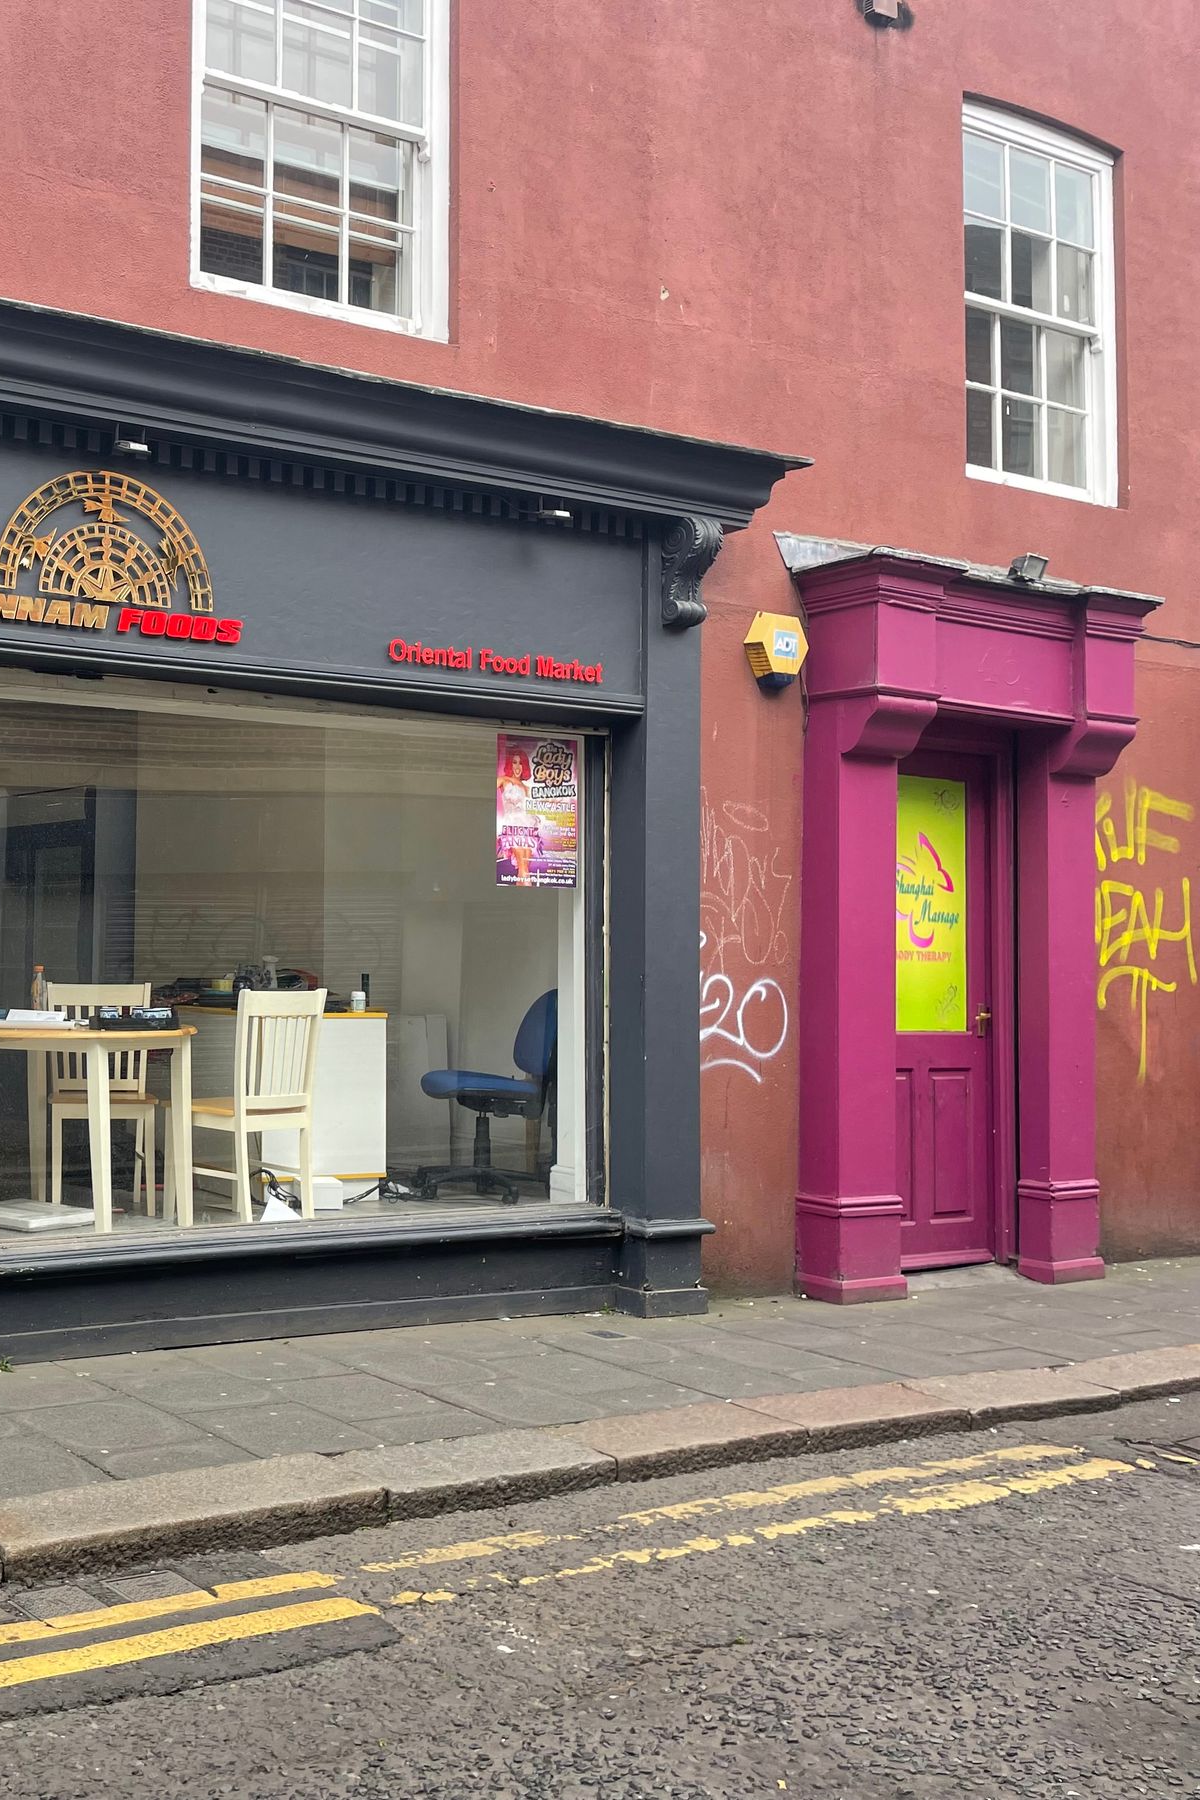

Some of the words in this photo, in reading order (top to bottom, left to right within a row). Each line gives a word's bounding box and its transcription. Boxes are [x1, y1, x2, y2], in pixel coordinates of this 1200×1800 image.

[117, 607, 244, 644] FOODS
[775, 636, 798, 653] ADT
[389, 637, 473, 670] Oriental
[480, 648, 531, 676] Food
[535, 655, 603, 684] Market
[532, 747, 572, 769] Lady
[534, 764, 571, 785] Boys
[532, 785, 575, 798] BANGKOK
[526, 800, 575, 812] NEWCASTLE
[914, 899, 960, 931] Massage
[916, 951, 953, 962] THERAPY
